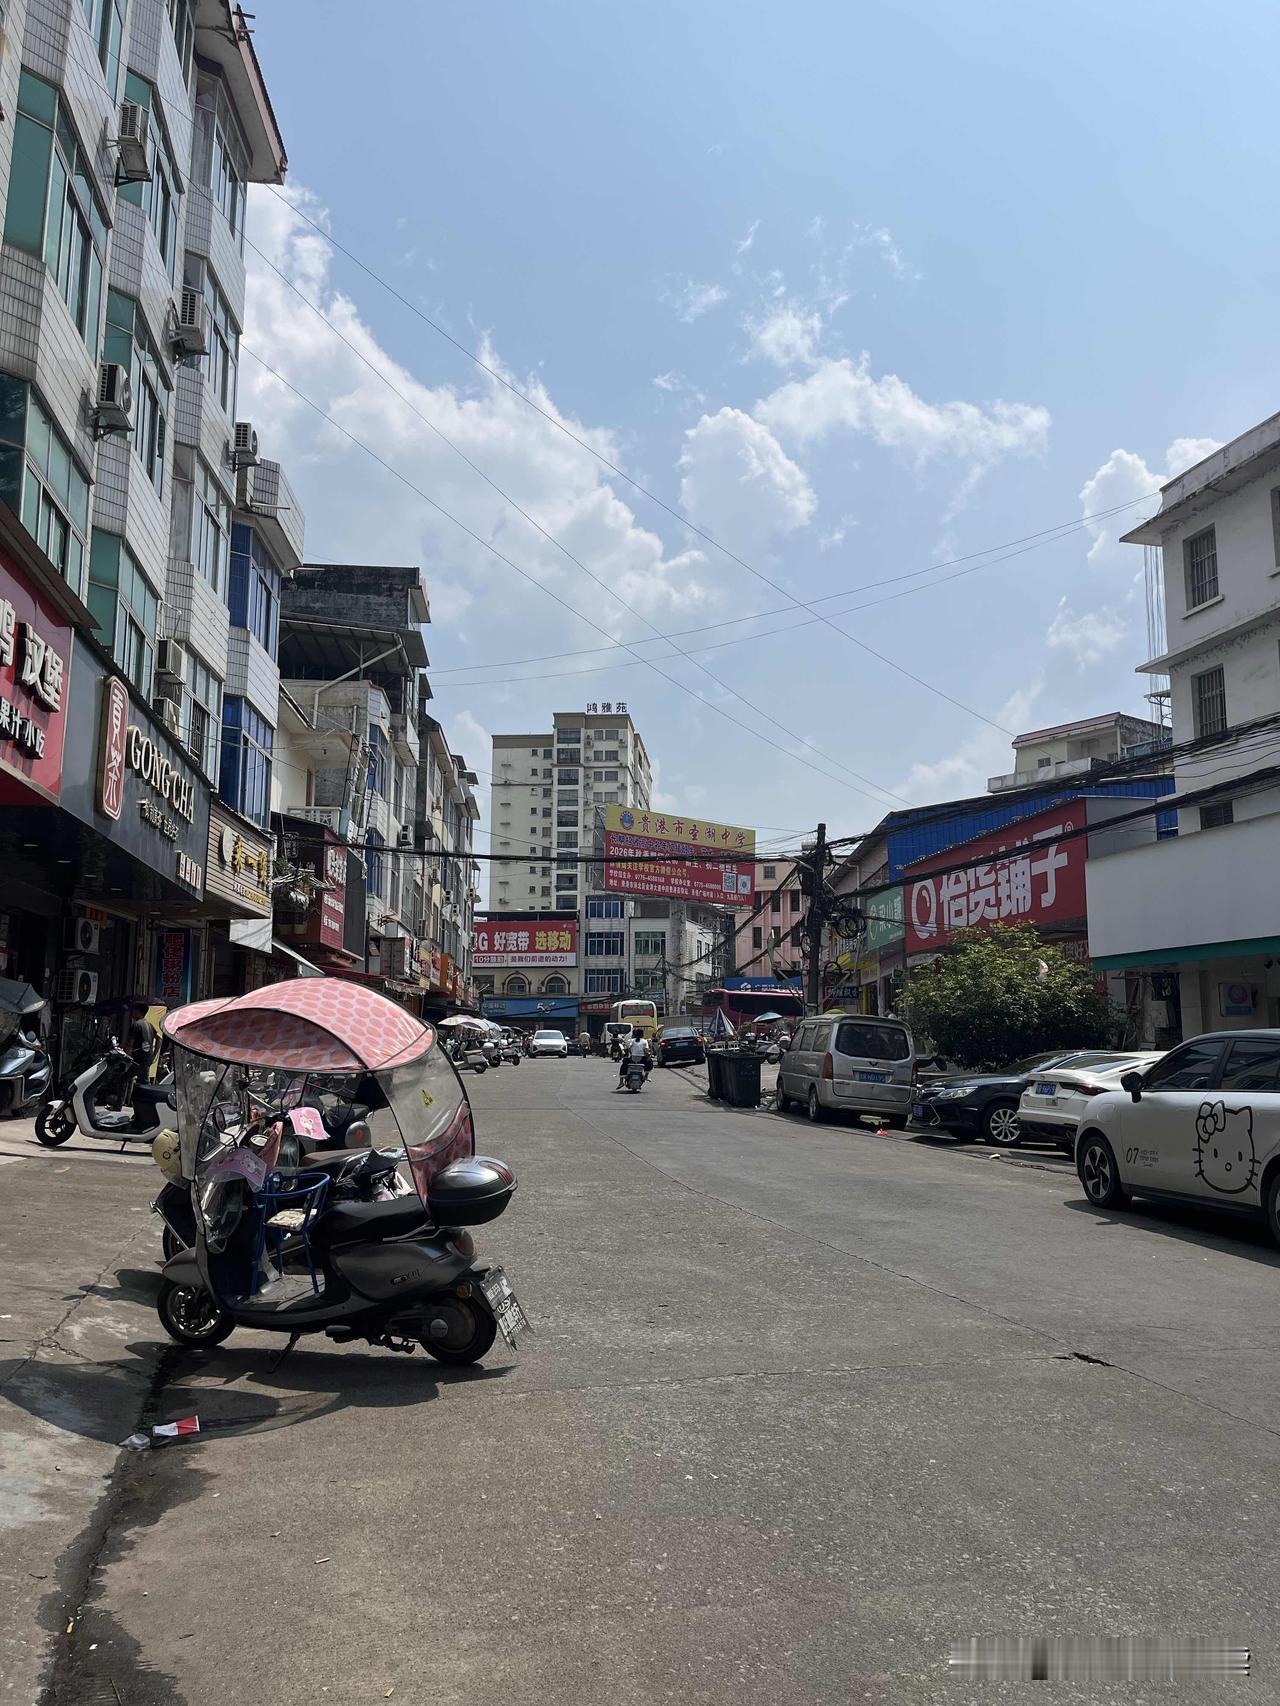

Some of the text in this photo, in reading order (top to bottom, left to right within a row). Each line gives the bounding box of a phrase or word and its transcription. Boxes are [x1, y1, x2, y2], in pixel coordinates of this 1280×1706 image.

[586, 702, 627, 713] 鸿雅苑
[131, 725, 172, 798] GONG
[172, 771, 194, 824] CHA
[638, 814, 746, 848] 贵港市圣湖中学
[494, 931, 530, 951] 好宽带
[535, 931, 572, 951] 选移动
[1126, 1148, 1139, 1165] 07
